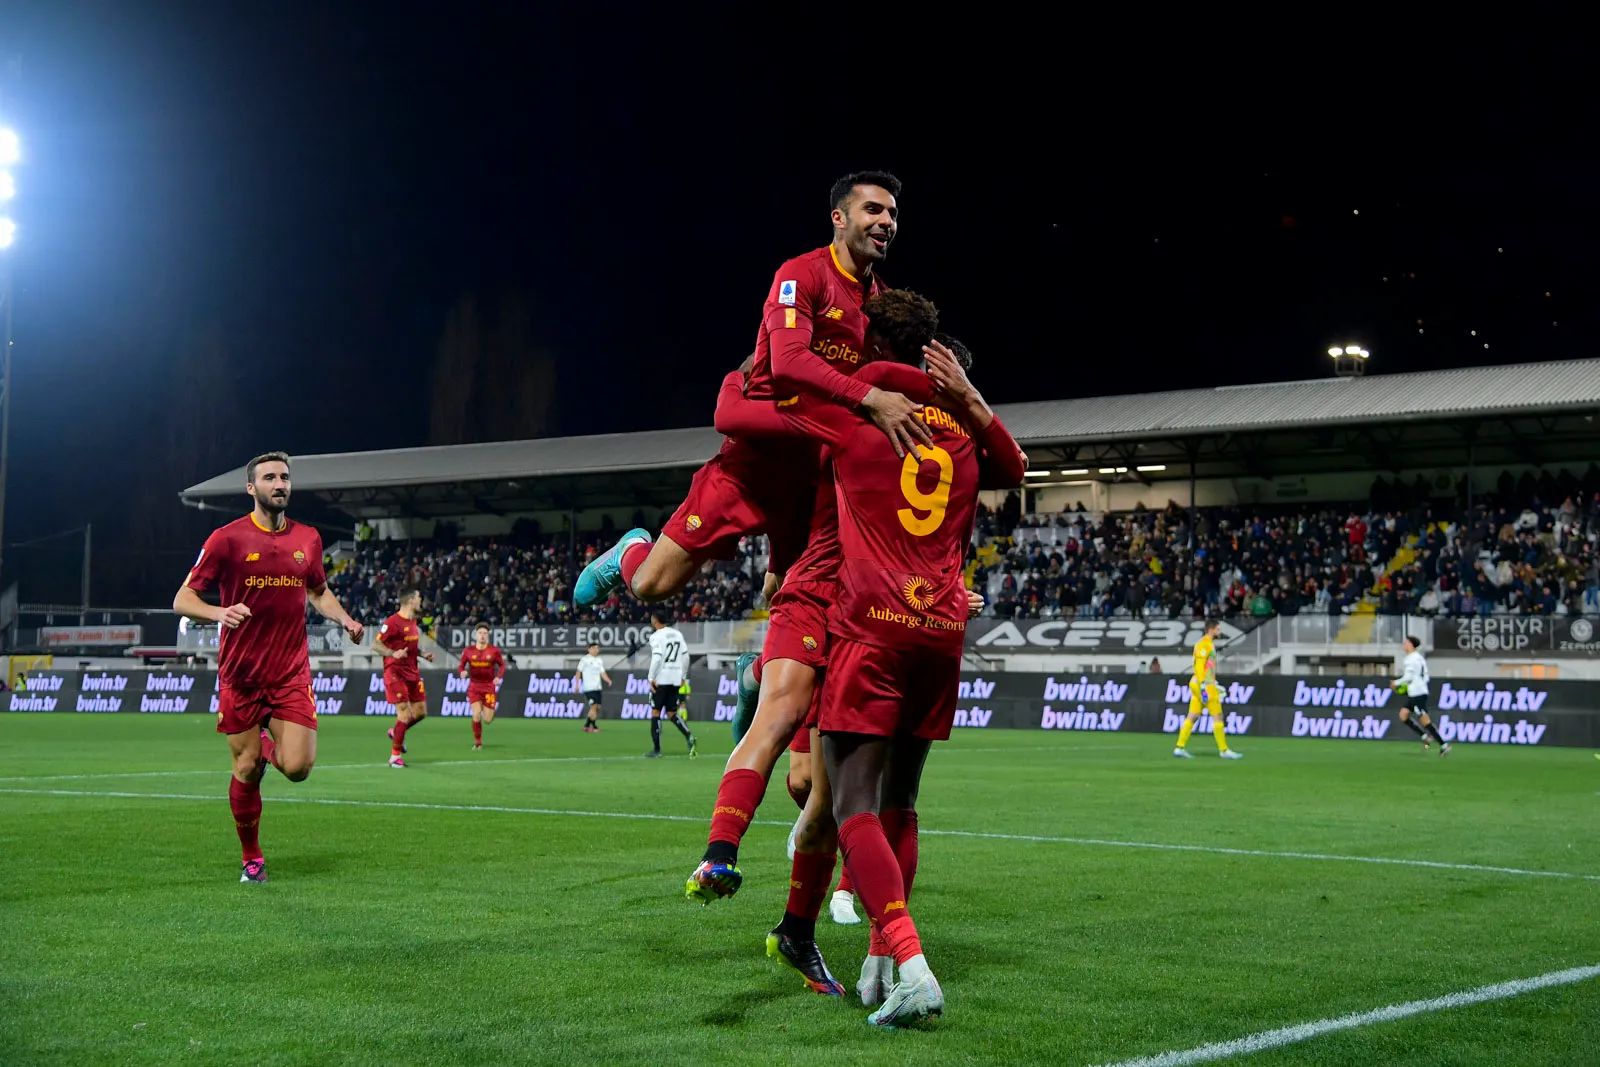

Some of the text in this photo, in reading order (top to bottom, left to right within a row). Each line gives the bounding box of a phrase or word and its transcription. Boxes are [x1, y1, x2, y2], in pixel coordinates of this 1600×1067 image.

[897, 444, 954, 536] 9
[245, 576, 303, 589] digitalbits
[867, 606, 922, 628] Auberge
[1457, 618, 1543, 634] ZEPHYR
[576, 626, 652, 646] ECOLOG
[1457, 634, 1529, 650] GROUP
[665, 641, 680, 662] 27
[26, 672, 64, 691] win.tv
[82, 672, 128, 691] bwin.tv
[146, 672, 195, 691] bwin.tv
[958, 678, 996, 699] n.tv
[1043, 676, 1128, 702] bwin.tv
[9, 693, 58, 711] bwin.tv
[76, 694, 122, 712] bwin.tv
[140, 693, 189, 712] bwin.tv
[1294, 679, 1391, 707] bwin.tv
[1438, 682, 1547, 712] bwin.tv
[524, 696, 584, 718] bwin.tv
[952, 706, 993, 727] n.tv
[1041, 704, 1125, 731] bwin.tv
[1291, 710, 1391, 739] bwin.tv
[1438, 715, 1547, 744] bwin.tv
